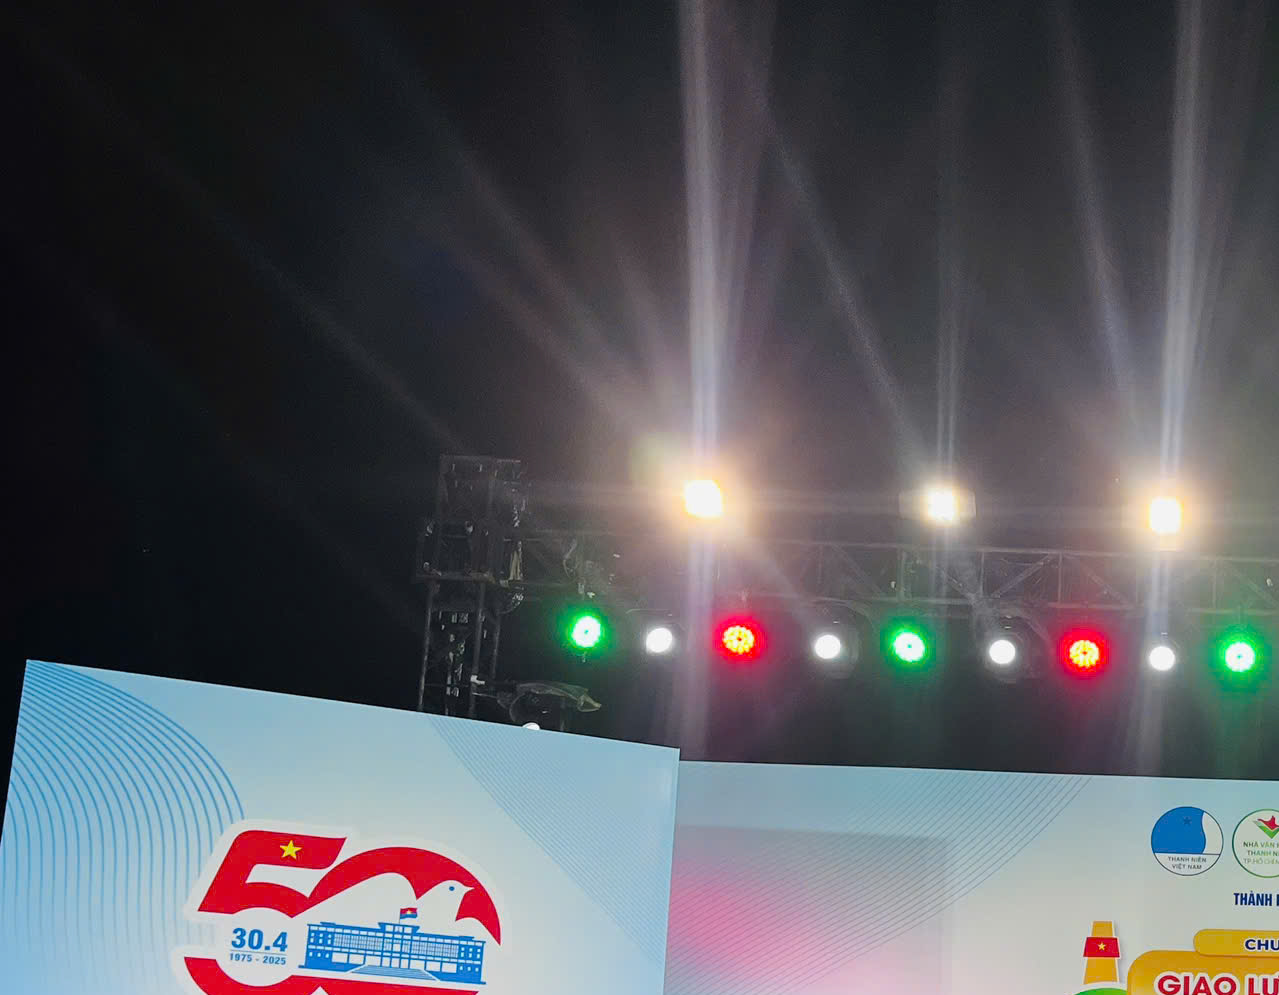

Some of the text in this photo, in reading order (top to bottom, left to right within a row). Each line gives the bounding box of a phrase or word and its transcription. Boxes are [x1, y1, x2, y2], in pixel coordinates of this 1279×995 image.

[1233, 890, 1273, 907] THÀNH
[231, 928, 288, 952] 30.4
[230, 953, 252, 962] 1975
[263, 955, 286, 965] 2025
